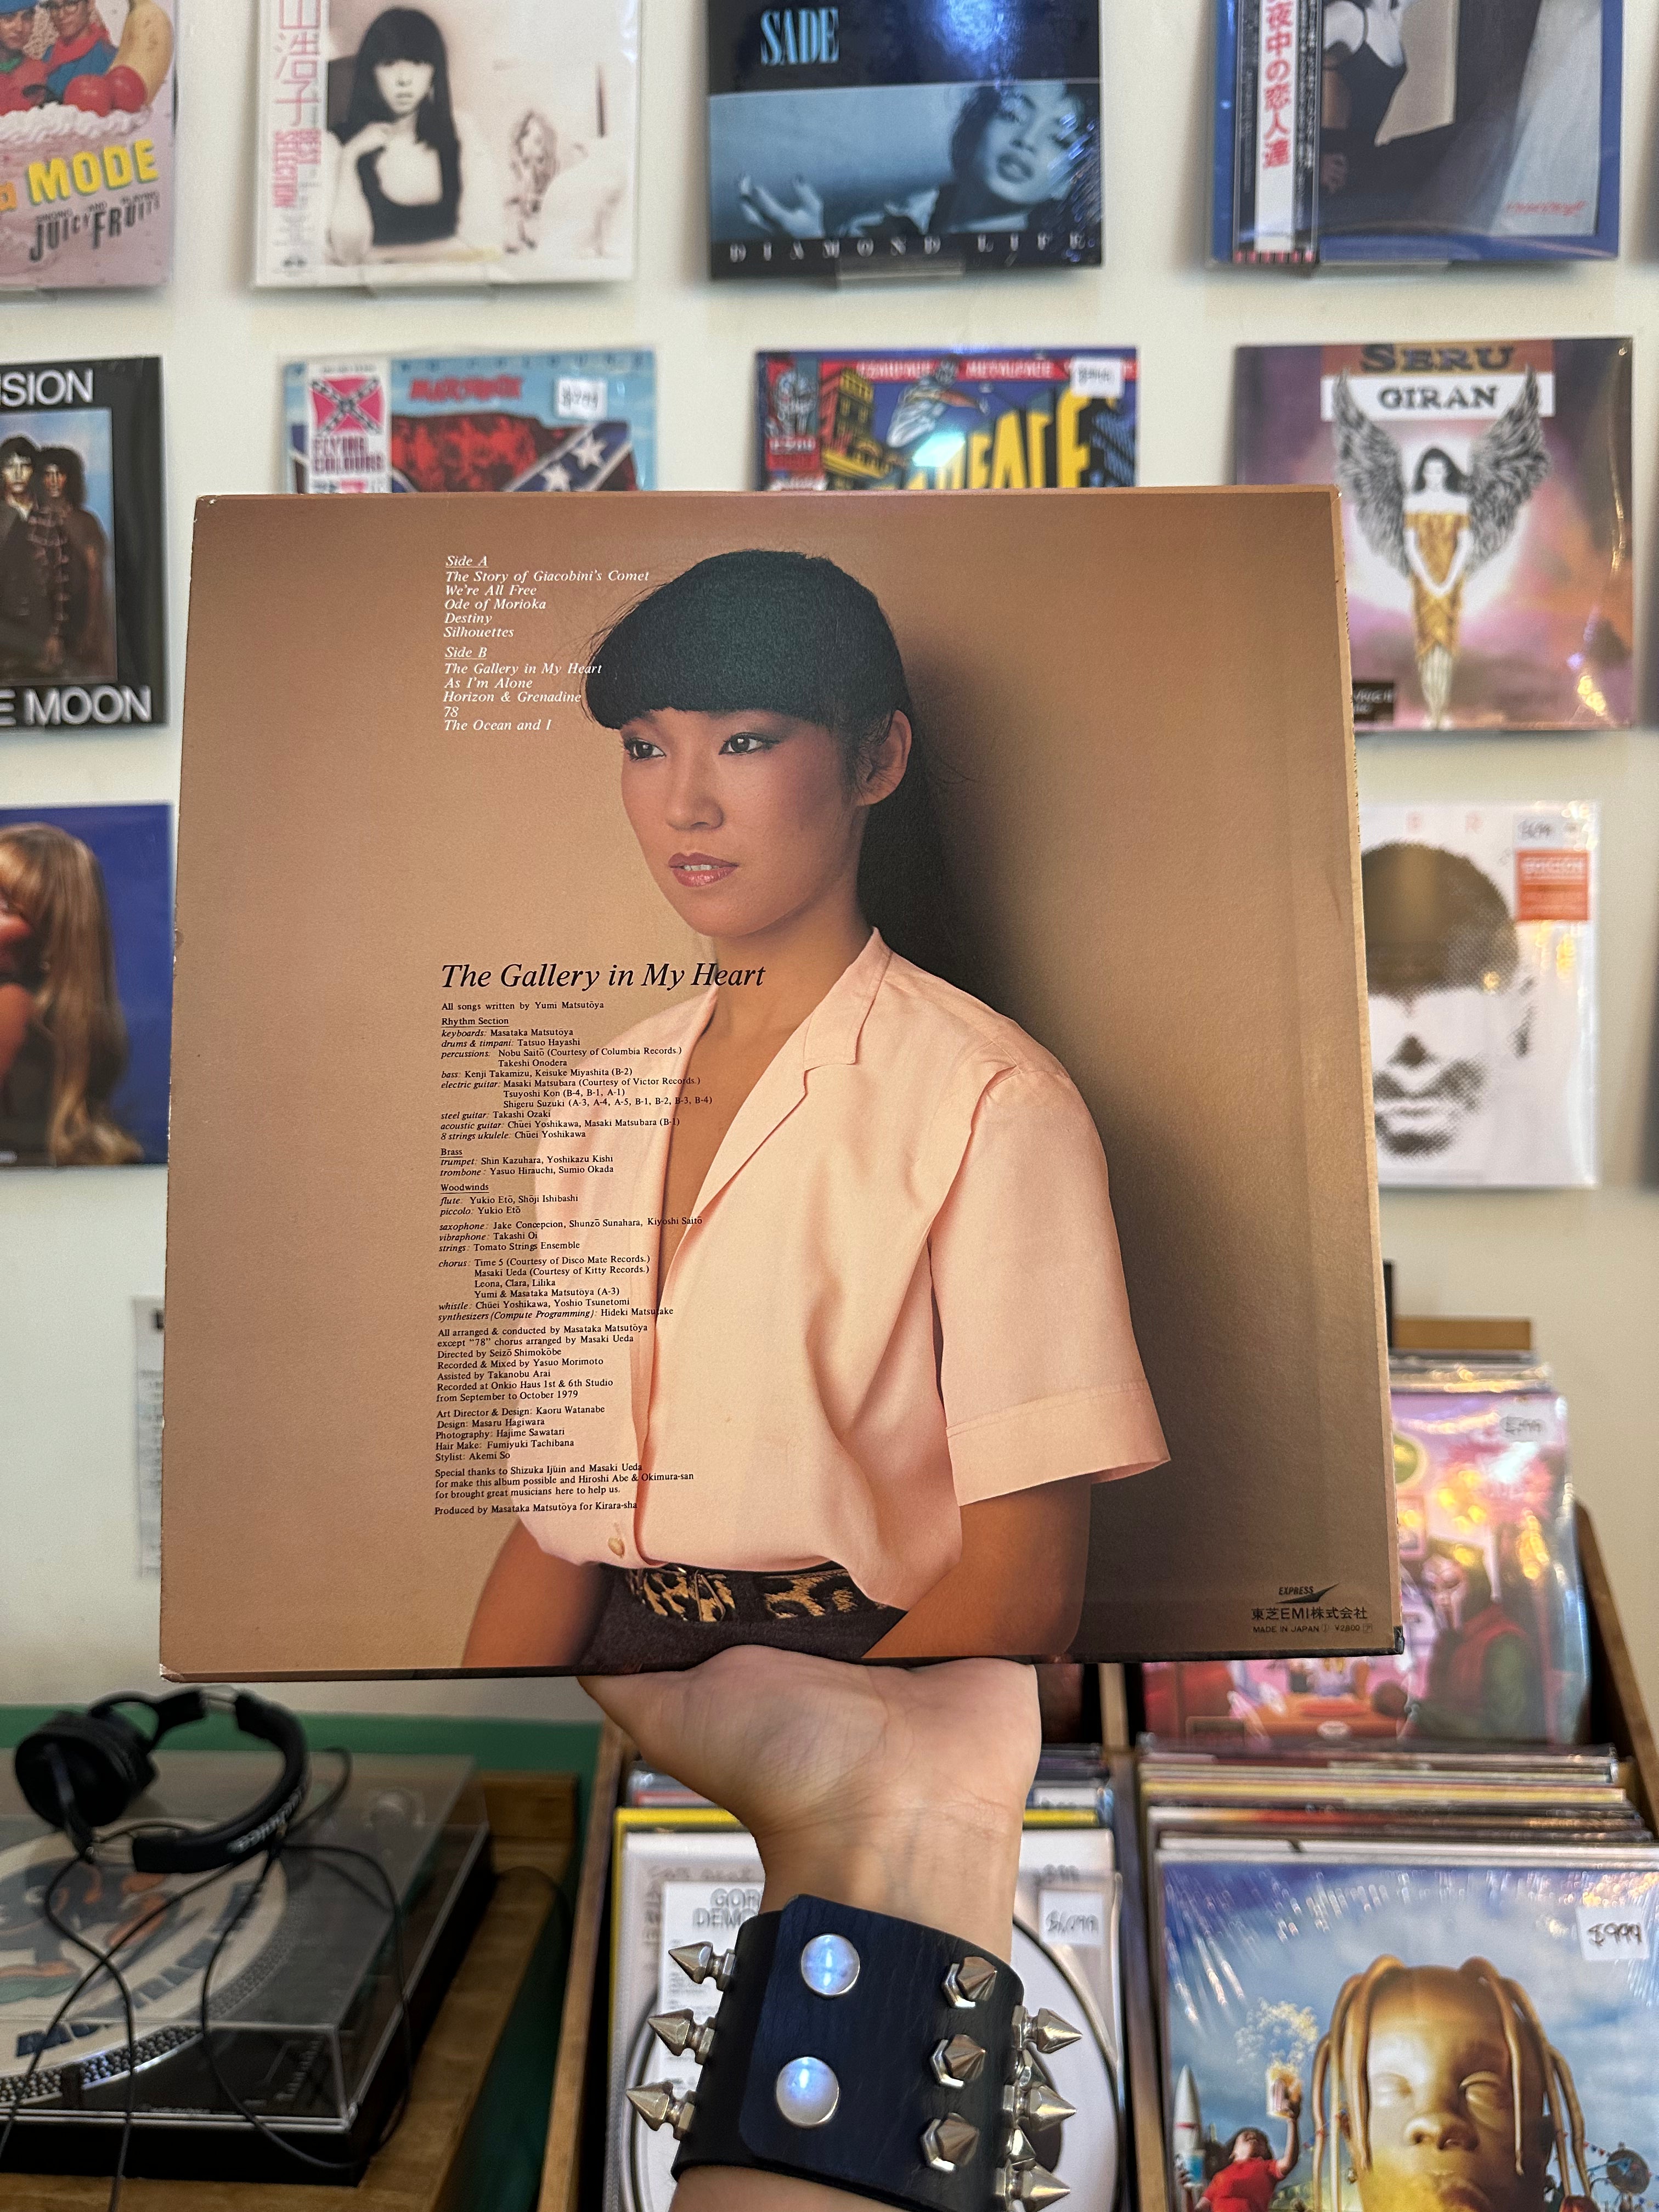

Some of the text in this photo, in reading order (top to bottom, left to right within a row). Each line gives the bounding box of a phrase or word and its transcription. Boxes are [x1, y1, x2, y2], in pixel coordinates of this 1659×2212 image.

[760, 8, 839, 65] SADE
[1263, 0, 1293, 168] 夜中の恋人達
[26, 139, 159, 206] MODE
[730, 230, 1085, 262] DIAMOND LIFE
[1361, 343, 1515, 373] SERU
[0, 368, 93, 408] SION
[1378, 386, 1497, 409] GIRAN
[445, 555, 487, 566] Side A
[445, 569, 649, 583] The Story of Giacobini's Comet
[446, 584, 537, 595] We're All Free
[444, 598, 546, 611] Ode of Morioka
[444, 612, 493, 625] Destiny
[443, 626, 515, 637] Silhouettes
[444, 646, 488, 658] Side B
[444, 662, 603, 676] The Gallery in My Heart
[444, 676, 533, 688] As I'm Alone
[442, 691, 582, 702] Horizon & Grenadine
[24, 685, 153, 725] MOON
[444, 706, 460, 718] 78
[444, 719, 552, 731] The Ocean and I
[442, 963, 766, 991] The Gallery in My Heart
[519, 1002, 530, 1011] by
[441, 1017, 476, 1026] Rhythm
[469, 1039, 477, 1047] &
[516, 1039, 546, 1049] Tatsuo
[548, 1038, 580, 1047] Hayashi
[498, 1059, 530, 1067] Takeshi
[441, 1111, 460, 1119] steel
[492, 1110, 524, 1121] Takashi
[527, 1109, 551, 1118] Ozaki
[448, 1132, 476, 1141] strings
[541, 1130, 586, 1138] Yoshikawa
[440, 1183, 489, 1191] Woodwinds
[509, 1242, 538, 1251] Strings
[540, 1241, 580, 1249] Ensemble
[474, 1278, 556, 1288] Leona, Clara, Lilika
[437, 1350, 474, 1358] Directed
[476, 1350, 487, 1358] by
[437, 1361, 478, 1369] Recorded
[479, 1360, 488, 1368] &
[490, 1359, 517, 1368] Mixed
[518, 1359, 530, 1368] by
[533, 1358, 559, 1367] Yasuo
[437, 1369, 551, 1380] Assisted by Takanobu Arai
[437, 1382, 478, 1391] Recorded
[490, 1381, 517, 1390] Onkio
[520, 1380, 541, 1389] Haus
[544, 1380, 556, 1388] 1st
[557, 1379, 566, 1387] &
[568, 1379, 583, 1387] 6th
[585, 1378, 614, 1386] Studio
[460, 1392, 506, 1402] September
[519, 1391, 555, 1400] October
[557, 1390, 579, 1398] 1979
[490, 1408, 499, 1416] &
[535, 1406, 562, 1414] Kaoru
[564, 1405, 605, 1413] Watanabe
[496, 1429, 527, 1438] Hajime
[528, 1428, 565, 1436] Sawatari
[469, 1451, 498, 1460] Akemi
[499, 1451, 511, 1459] So
[434, 1505, 475, 1515] Produced
[477, 1505, 488, 1515] by
[491, 1504, 531, 1513] Masataka
[579, 1502, 593, 1510] for
[595, 1500, 638, 1509] Kirara-sha
[1278, 1585, 1314, 1595] EXPRESS
[1251, 1606, 1368, 1620] 東芝EMI株式会社
